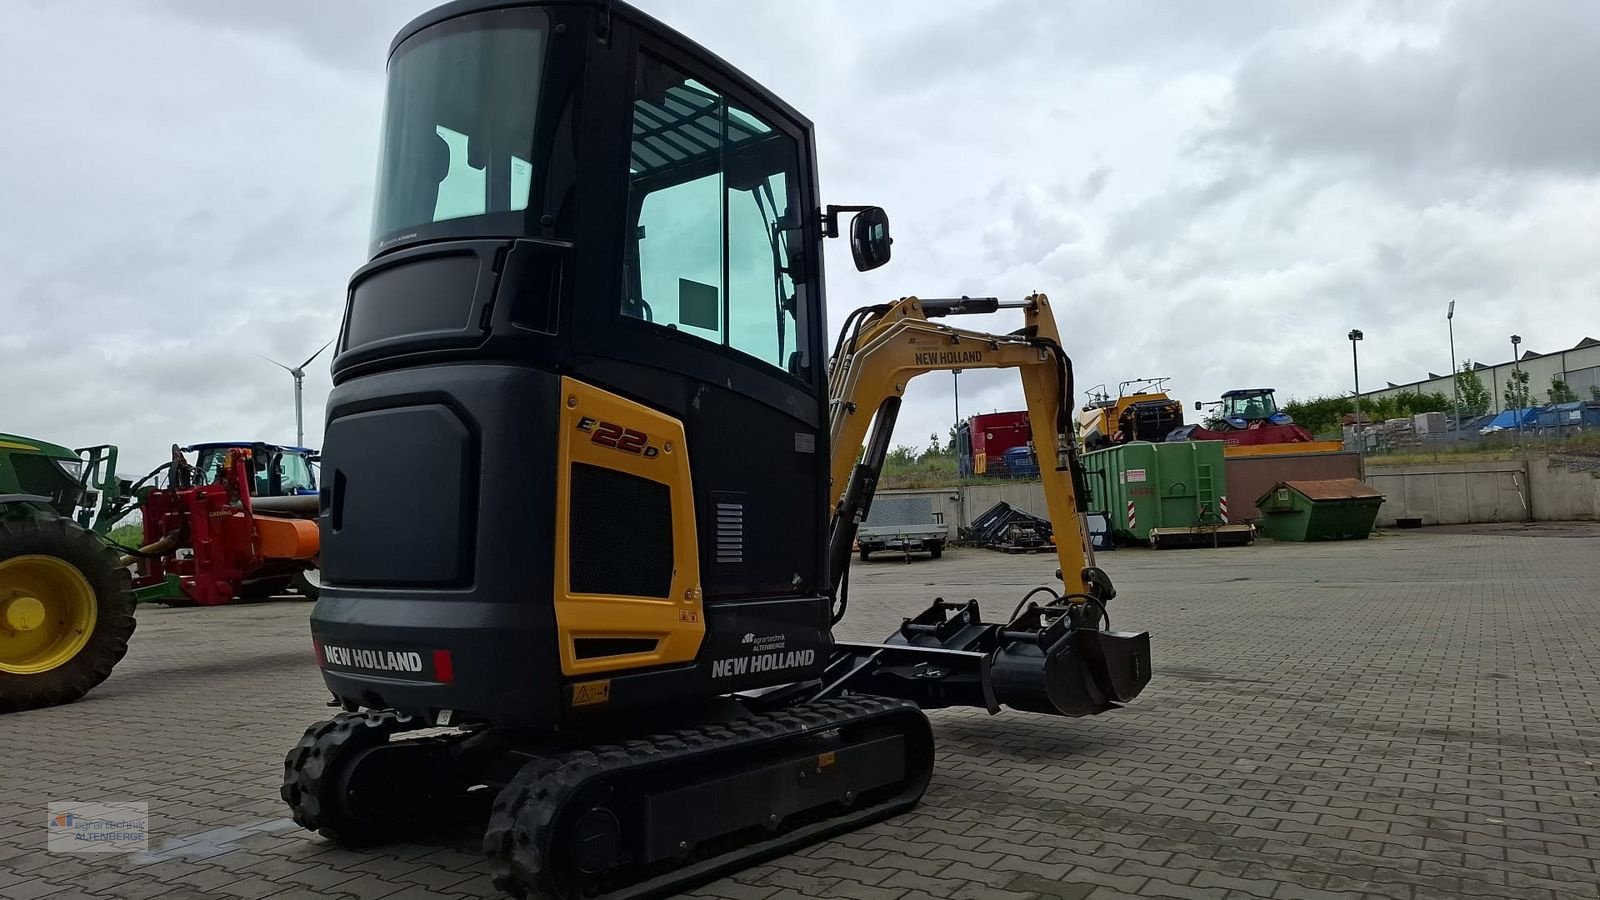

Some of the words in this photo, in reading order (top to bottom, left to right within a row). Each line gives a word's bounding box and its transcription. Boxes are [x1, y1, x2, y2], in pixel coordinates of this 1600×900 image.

[915, 351, 938, 365] NEW
[940, 350, 982, 364] HOLLAND
[324, 645, 351, 666] NEW
[352, 649, 423, 672] HOLLAND
[712, 657, 749, 678] NEW
[750, 649, 815, 673] HOLLAND
